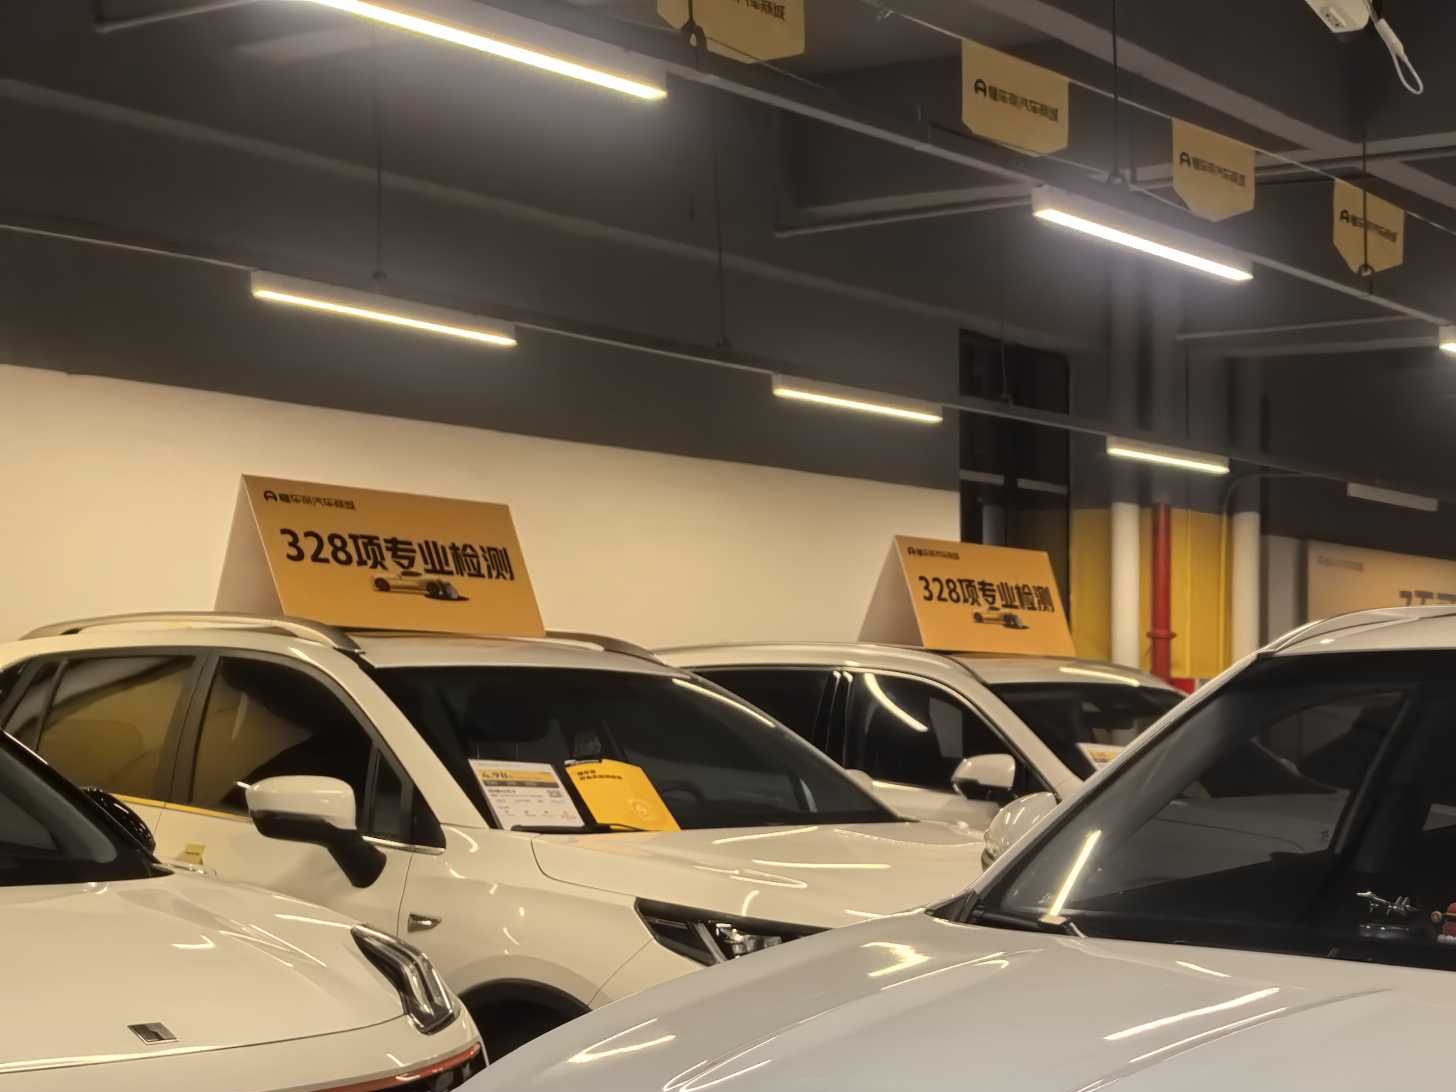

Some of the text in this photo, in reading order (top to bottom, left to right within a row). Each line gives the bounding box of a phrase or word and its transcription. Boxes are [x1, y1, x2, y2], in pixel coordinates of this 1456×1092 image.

[279, 527, 515, 581] 328项专业检测
[918, 575, 1056, 613] 328项专业检测
